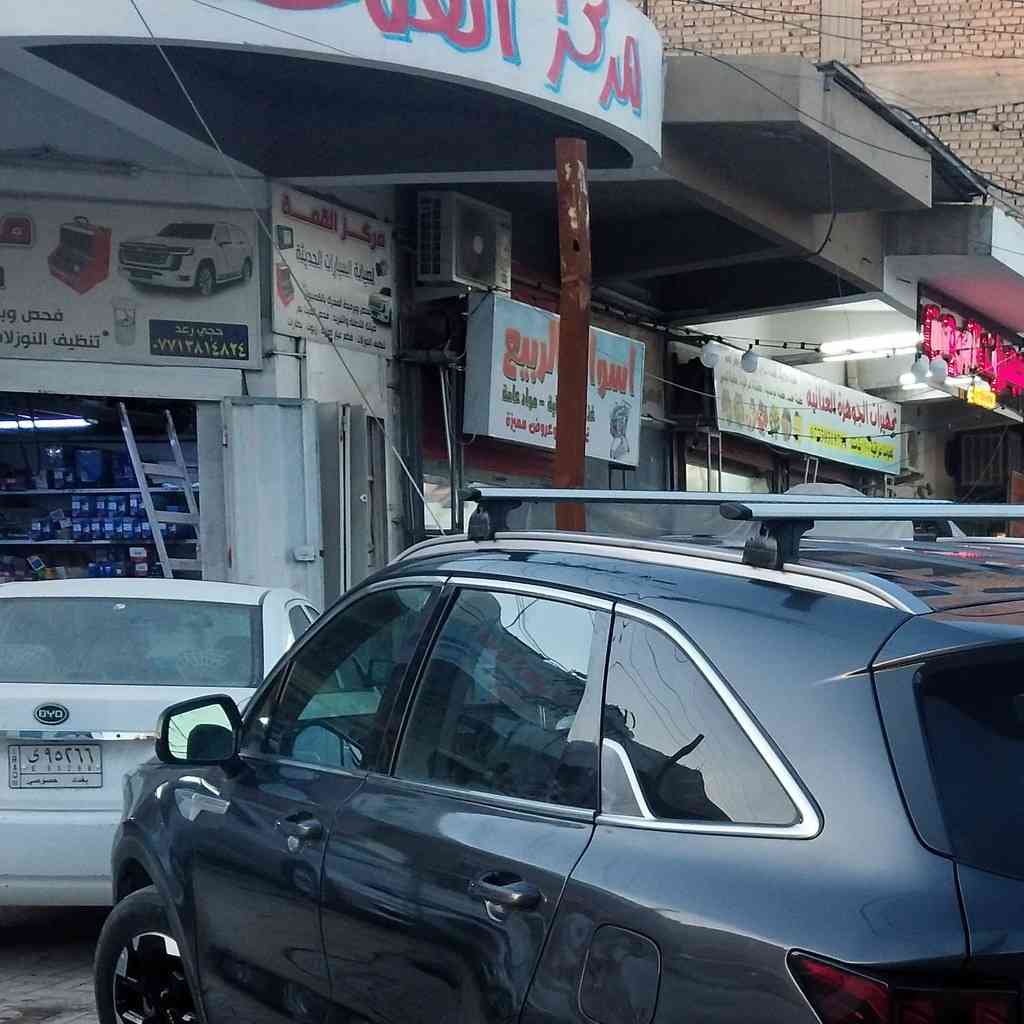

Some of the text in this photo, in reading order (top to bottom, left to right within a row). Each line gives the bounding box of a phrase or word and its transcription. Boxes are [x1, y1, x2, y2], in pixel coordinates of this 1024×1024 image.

[22, 307, 64, 324] فحص
[0, 329, 101, 351] تنظيف النوزلا
[503, 319, 637, 399] اسوا لربيع
[38, 709, 64, 718] BYD
